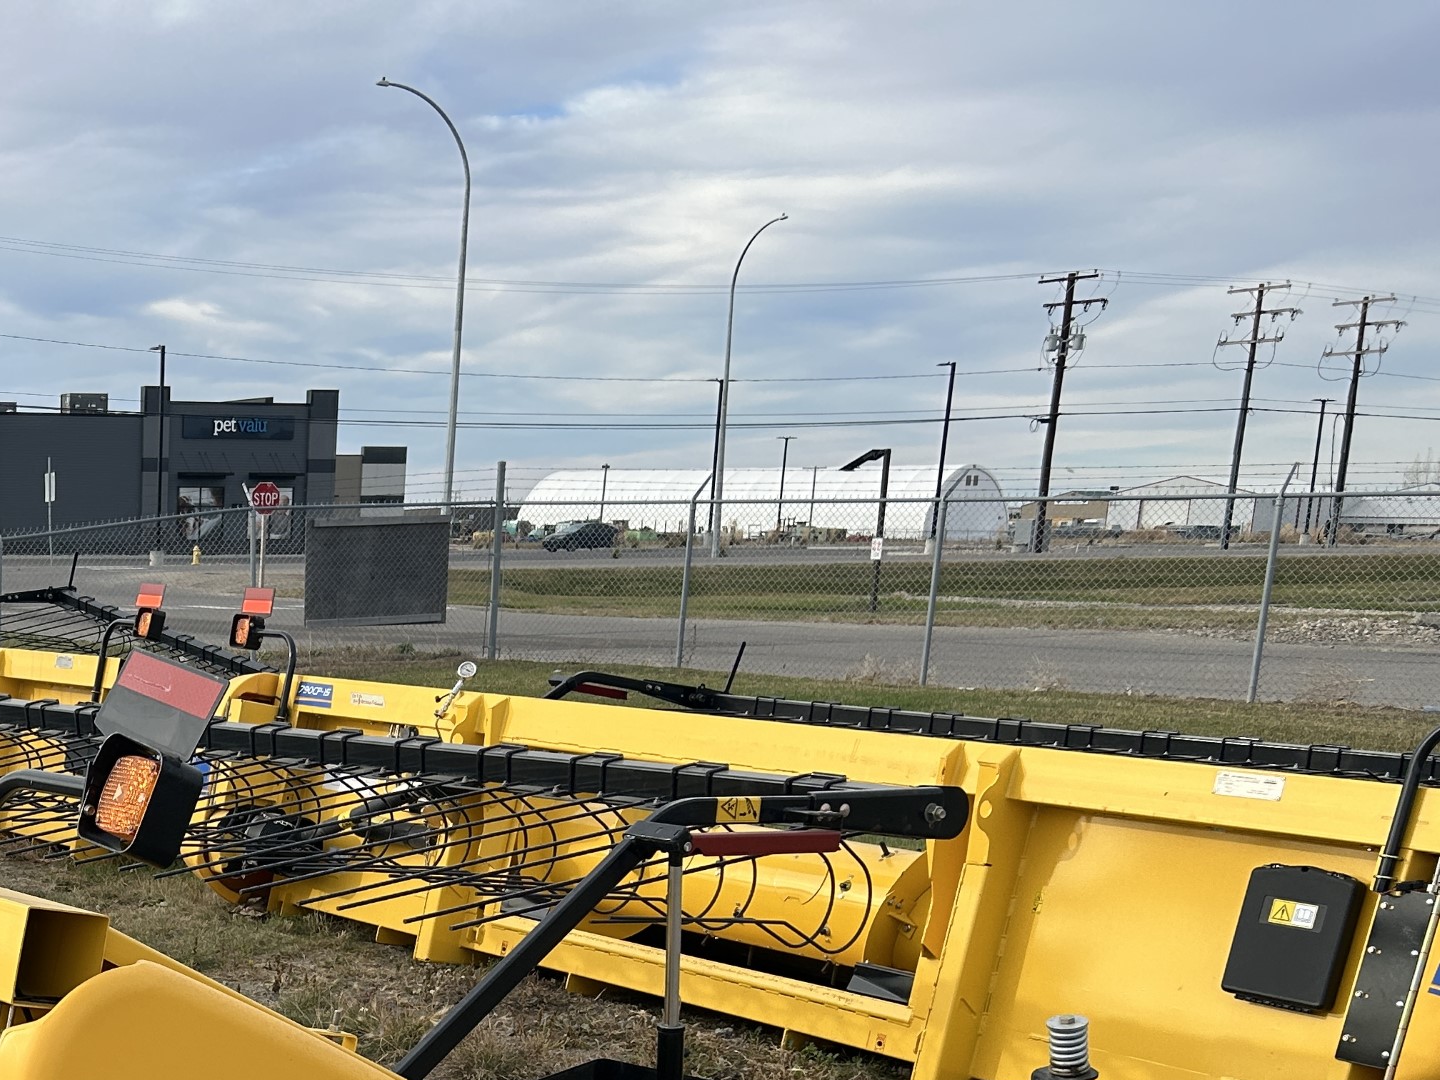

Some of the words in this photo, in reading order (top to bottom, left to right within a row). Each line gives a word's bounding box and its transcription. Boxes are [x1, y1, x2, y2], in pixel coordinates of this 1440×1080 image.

[213, 417, 237, 436] pet
[238, 418, 268, 433] valu
[253, 492, 278, 506] STOP
